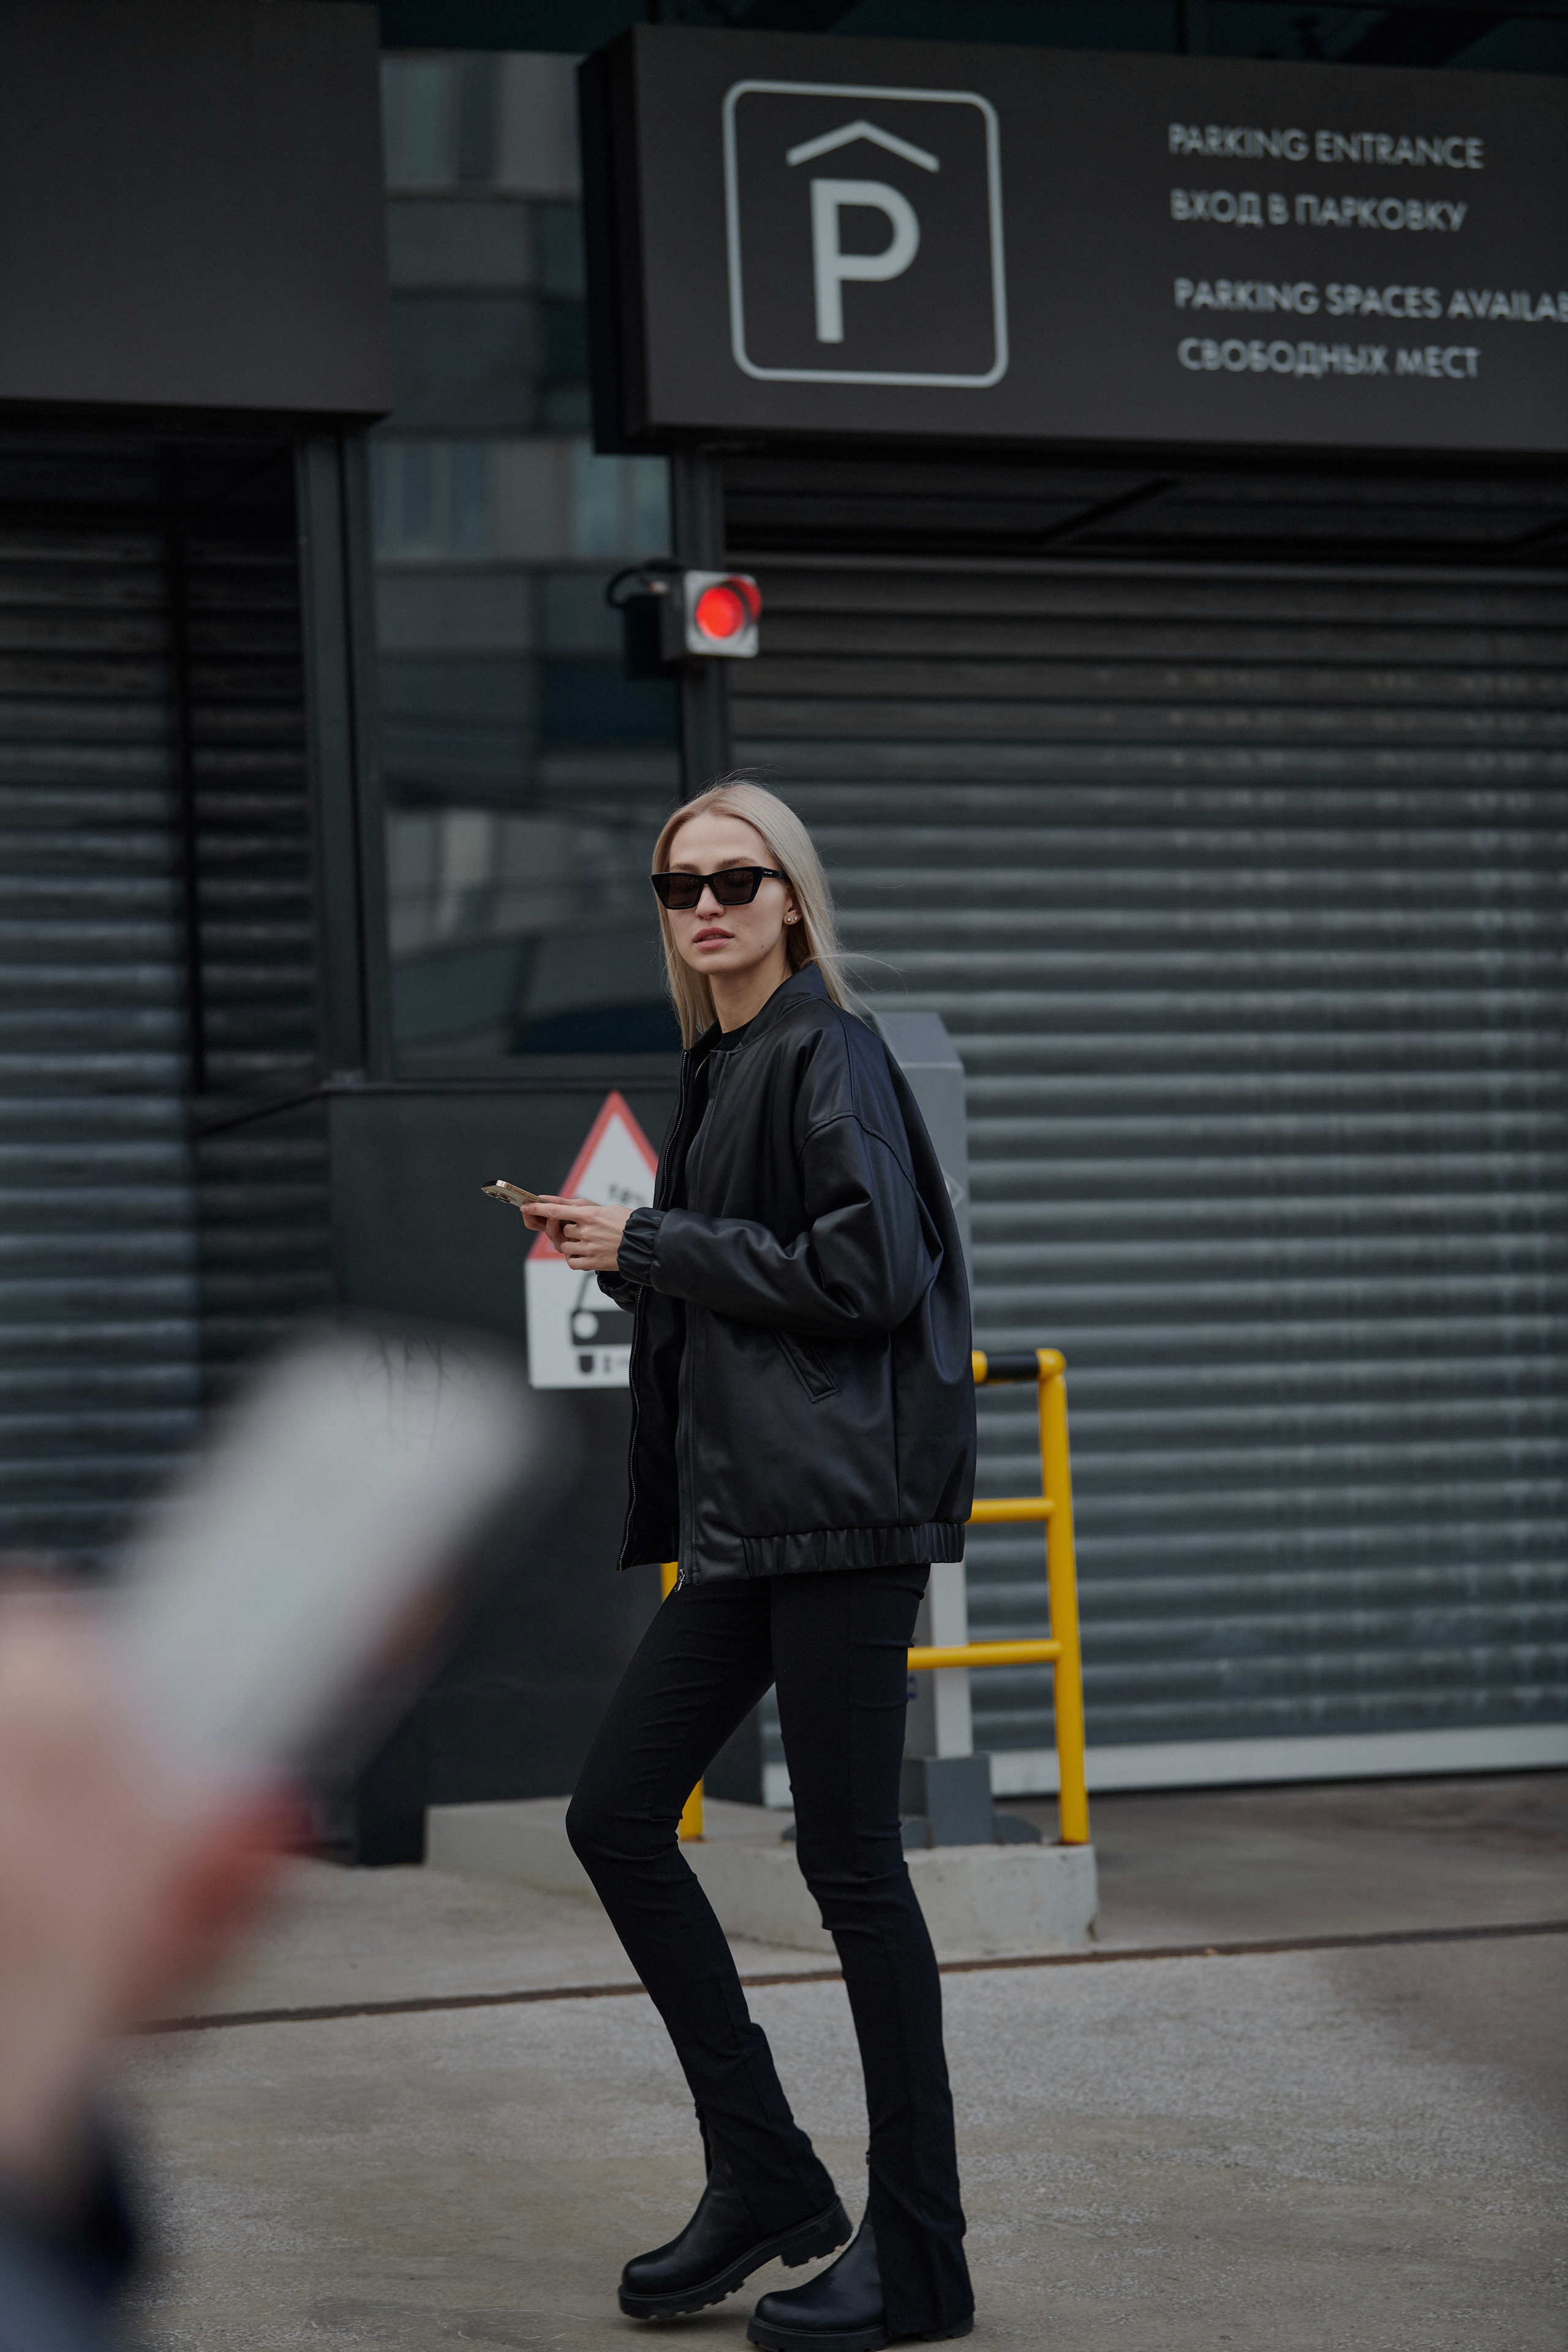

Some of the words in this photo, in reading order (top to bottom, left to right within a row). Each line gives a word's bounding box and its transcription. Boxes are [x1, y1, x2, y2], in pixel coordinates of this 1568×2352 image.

[1169, 123, 1308, 161] PARKING
[1316, 130, 1483, 169] ENTRANCE
[1170, 189, 1264, 227] ВХОД
[1268, 193, 1289, 225] В
[1295, 194, 1467, 231] ПАРКОВКУ
[810, 177, 921, 344] P
[1174, 277, 1320, 315] PARKING
[1325, 282, 1442, 319] SPACES
[1176, 336, 1390, 379] СВОБОДНЫХ
[1394, 345, 1481, 379] МЕСТ
